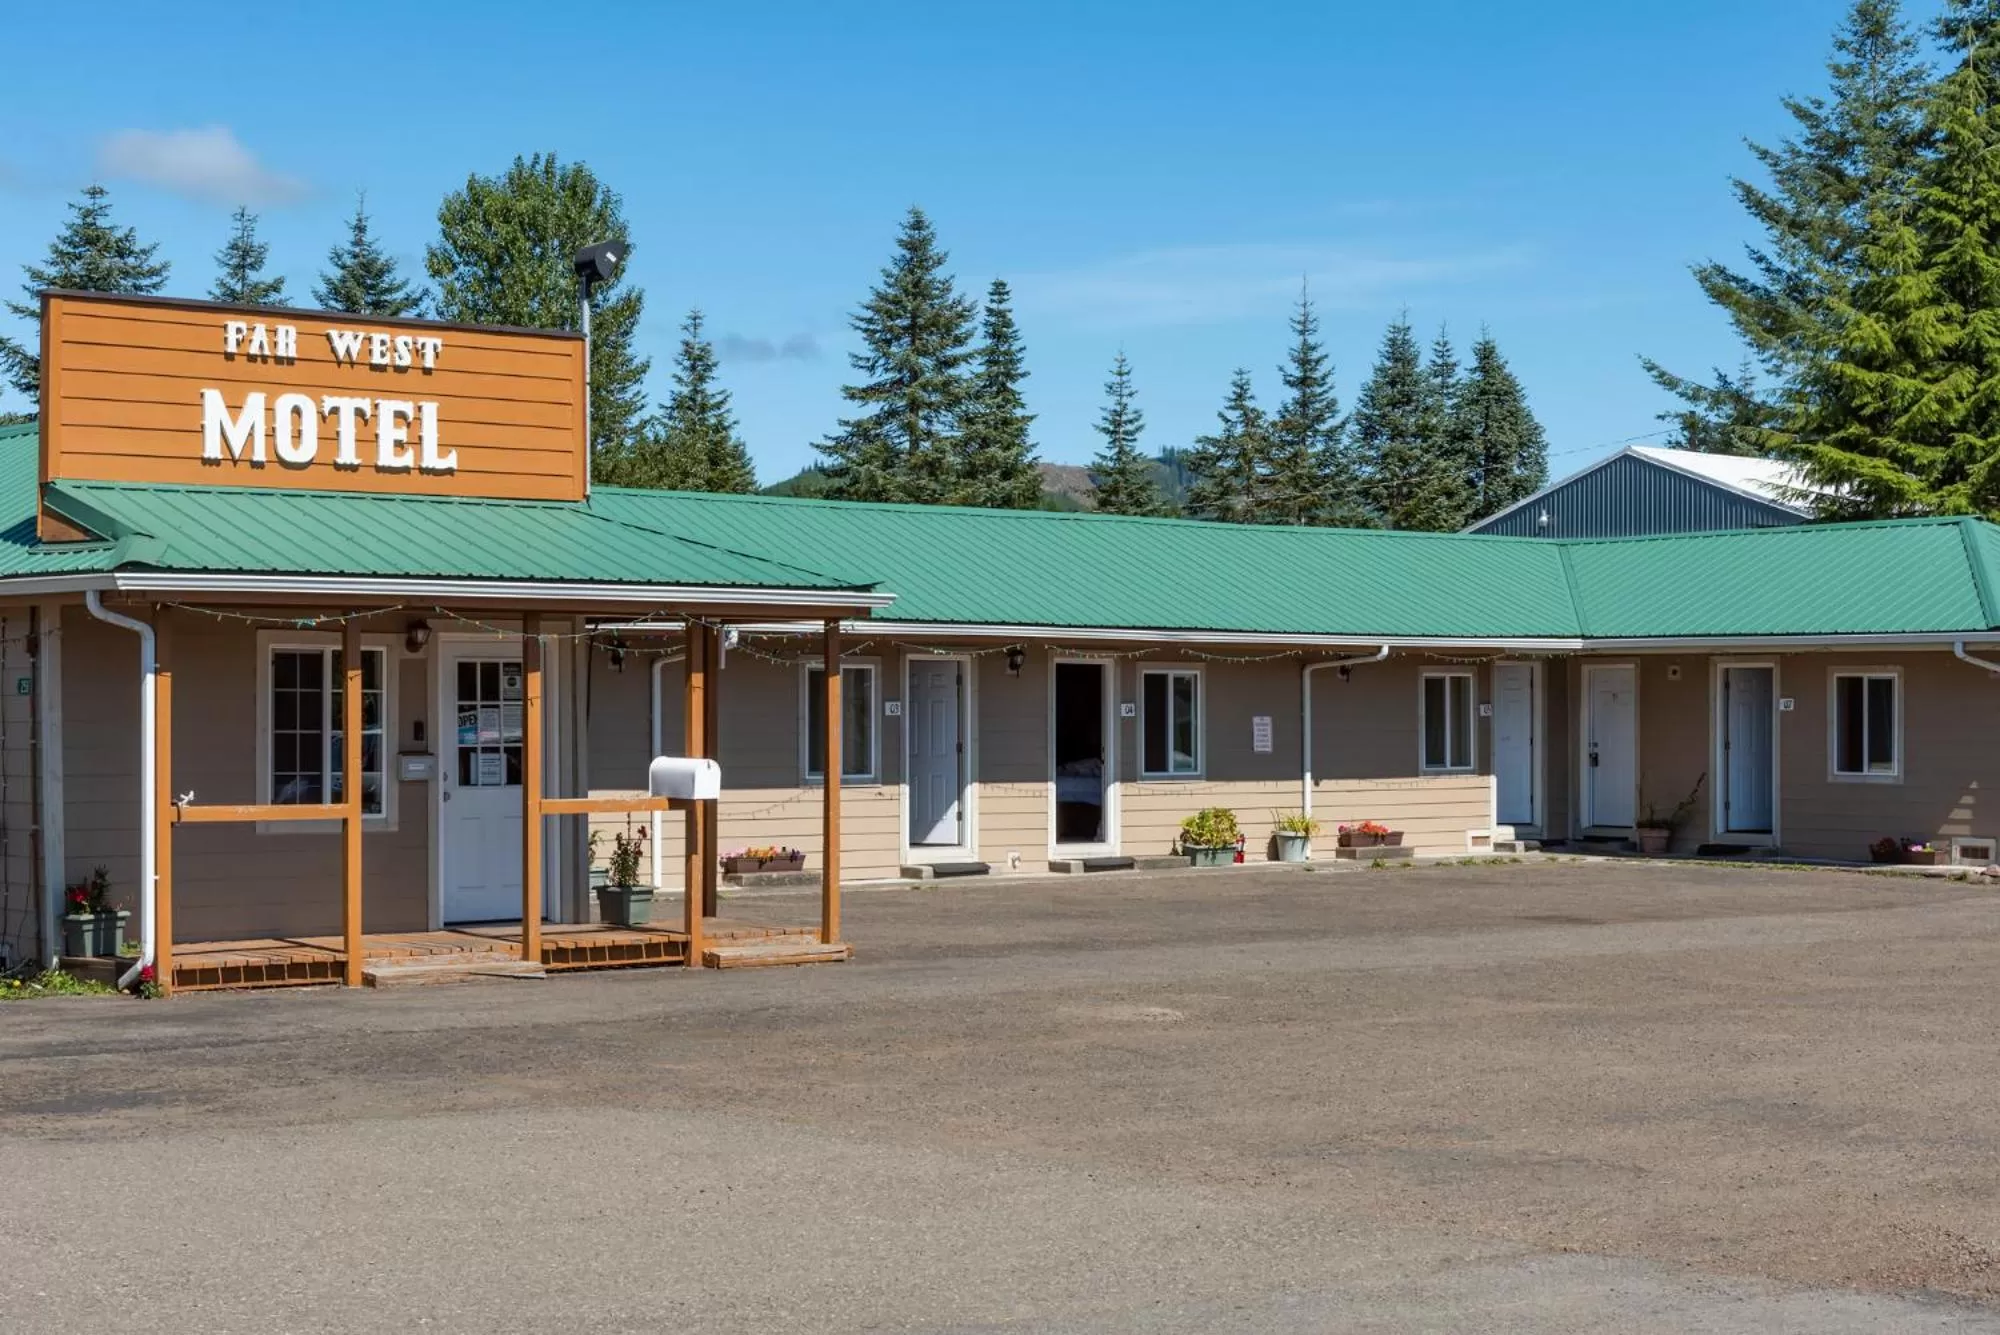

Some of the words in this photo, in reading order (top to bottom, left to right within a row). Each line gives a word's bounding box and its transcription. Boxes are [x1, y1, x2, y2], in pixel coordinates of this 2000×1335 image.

[224, 320, 298, 360] FAR
[326, 329, 443, 370] WEST
[200, 387, 458, 472] MOTEL
